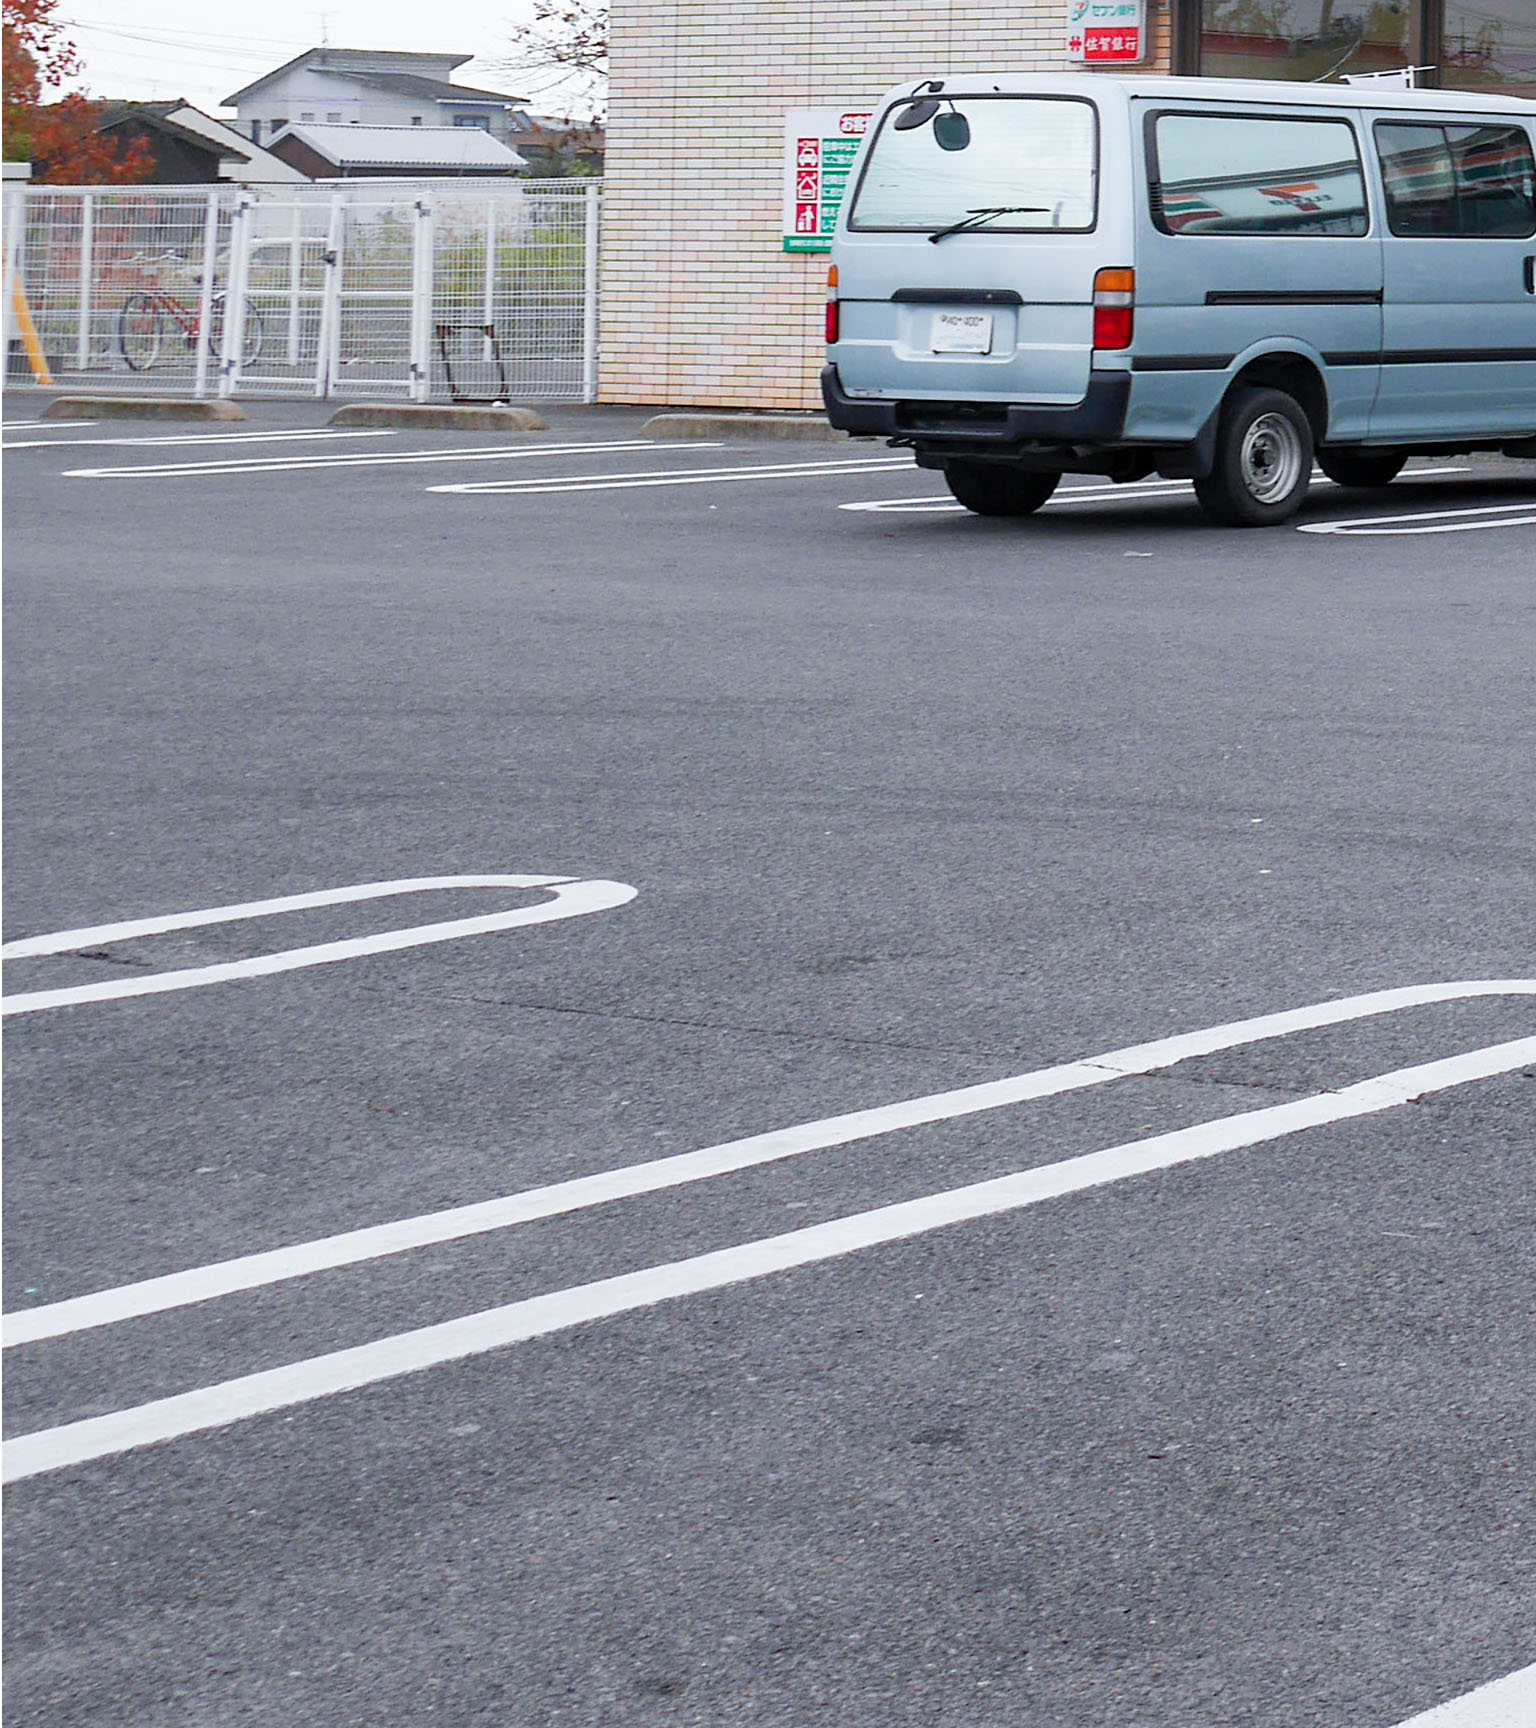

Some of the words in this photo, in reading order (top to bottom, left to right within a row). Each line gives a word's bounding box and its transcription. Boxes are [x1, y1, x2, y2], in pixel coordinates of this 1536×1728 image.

[1092, 4, 1137, 17] セブン銀行
[1085, 36, 1137, 52] 佐賀銀行
